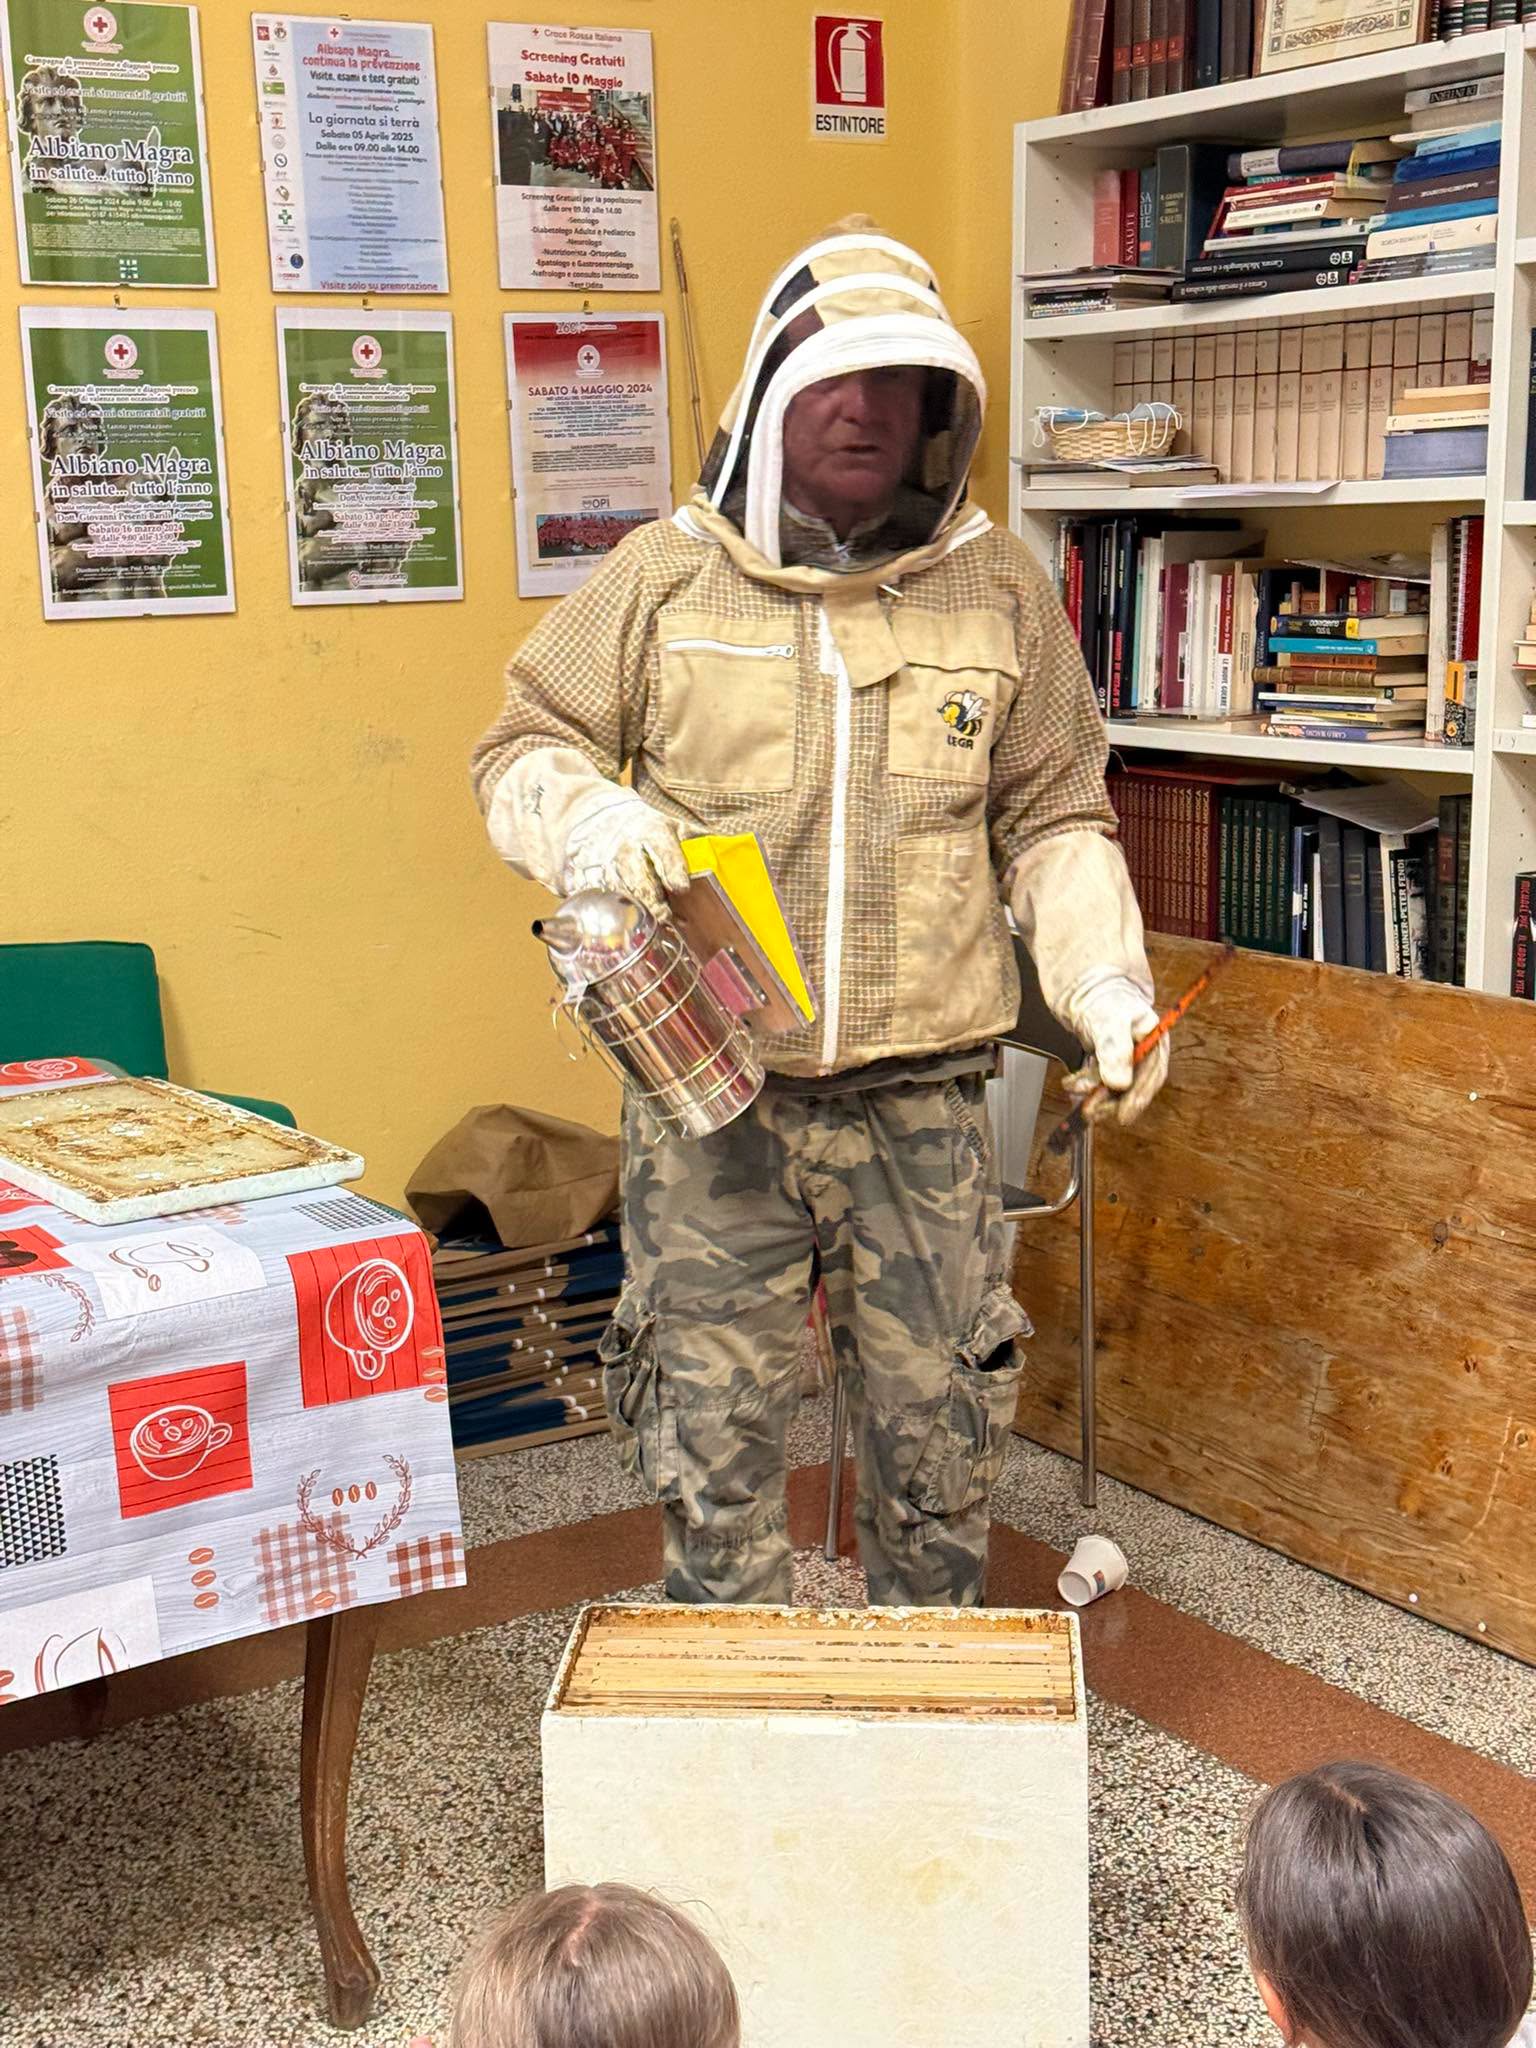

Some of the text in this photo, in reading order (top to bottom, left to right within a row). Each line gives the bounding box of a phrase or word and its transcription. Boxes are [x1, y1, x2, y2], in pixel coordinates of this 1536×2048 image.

[543, 28, 623, 42] Croce Rossa Italiana
[317, 43, 355, 57] Albiano
[302, 56, 421, 71] continua la prevenzione
[521, 49, 626, 68] Screening Gratuiti
[337, 73, 360, 82] esami
[369, 73, 386, 84] test
[387, 75, 420, 87] gratuiti
[524, 71, 623, 90] Sabato 10 Maggio
[308, 112, 420, 128] La giornata si terrà
[816, 114, 885, 134] ESTINTORE
[320, 129, 414, 142] Sabato 05 Aprile 2025
[30, 136, 191, 167] Albiano Magra
[316, 141, 420, 154] Dalle ore 09.00 alle 14.00
[31, 165, 46, 180] in
[111, 169, 145, 184] tutto
[149, 169, 193, 185] l'anno
[521, 193, 554, 203] Screening
[583, 196, 594, 204] per
[595, 195, 602, 203] la
[320, 281, 439, 293] Visite solo su prenotazione
[528, 383, 653, 397] SABATO 4 MAGGIO 2024
[301, 440, 445, 464] Albiano Magra
[50, 454, 211, 479] Albiano Magra
[305, 465, 318, 478] in
[373, 465, 402, 477] tutto
[404, 463, 442, 477] l'anno
[53, 483, 71, 497] in
[131, 482, 165, 496] tutto
[168, 480, 212, 495] l'anno
[79, 512, 117, 522] Giovanni
[334, 512, 362, 521] Sabato
[400, 511, 419, 520] 2024
[89, 522, 184, 535] Sabato 16 marzo 2024
[101, 533, 121, 543] dalle
[1202, 791, 1210, 824] MEDICA
